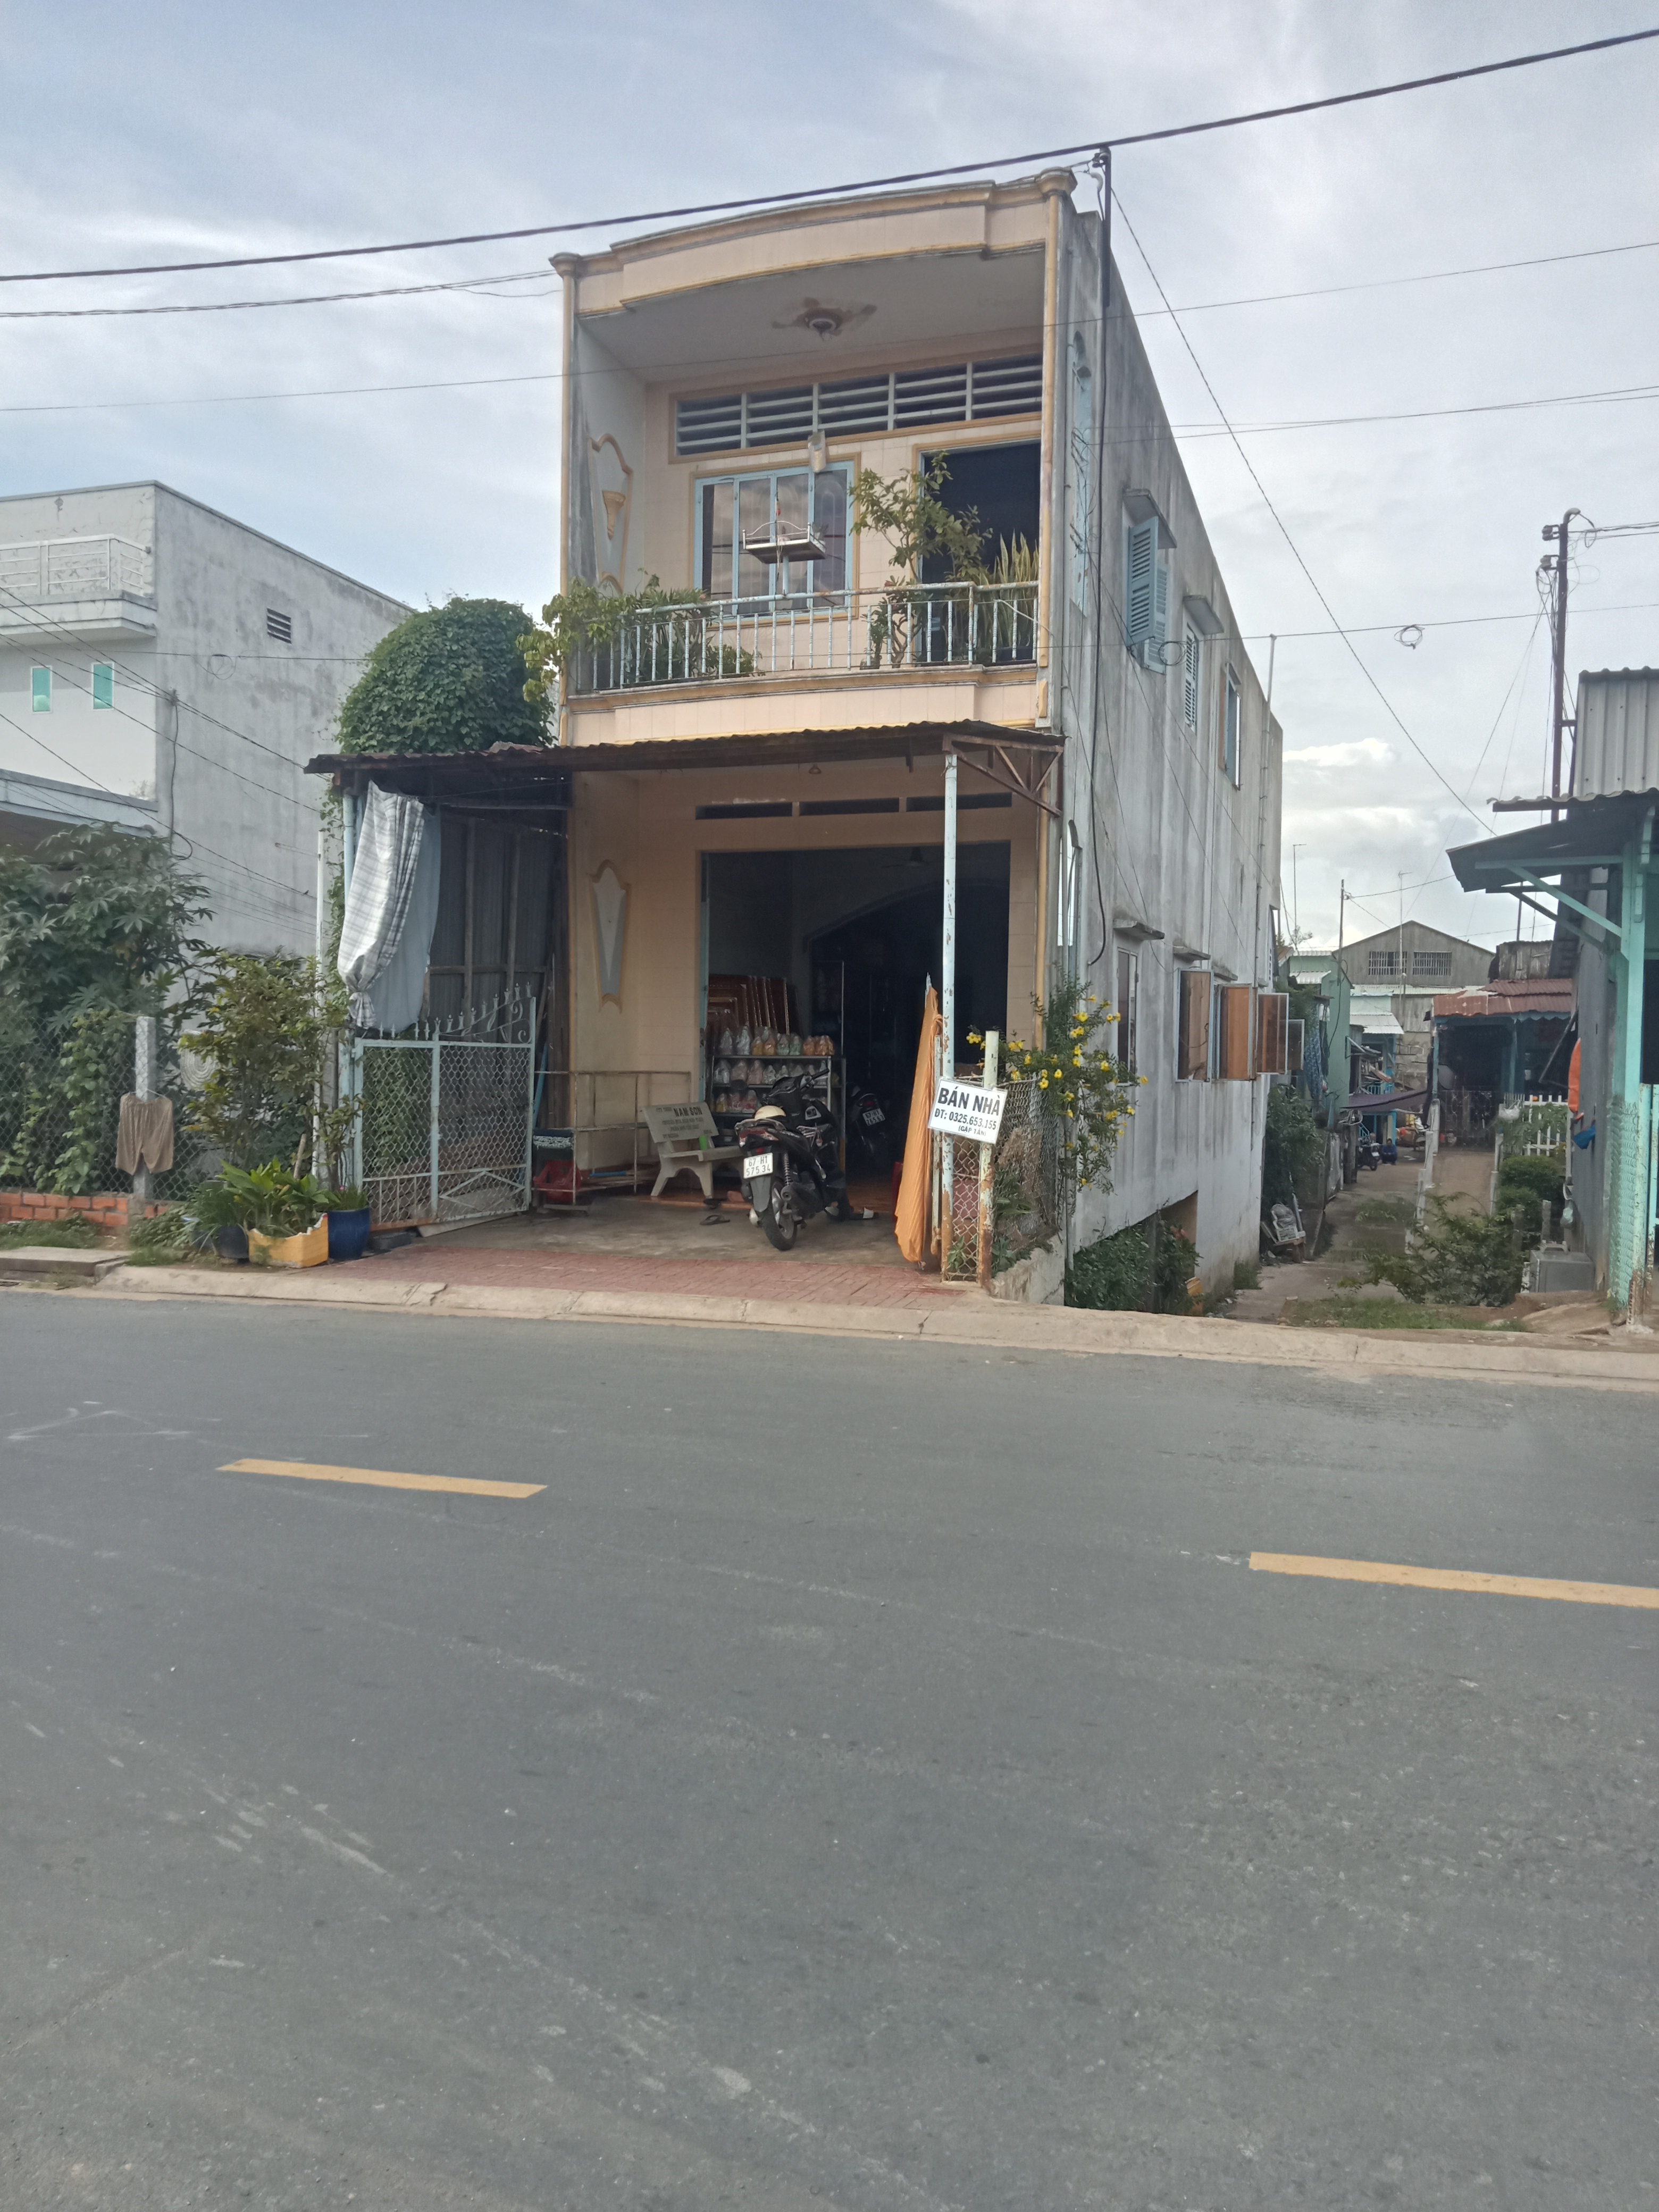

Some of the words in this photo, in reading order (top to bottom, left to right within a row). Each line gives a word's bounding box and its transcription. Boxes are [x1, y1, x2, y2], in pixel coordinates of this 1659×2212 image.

[937, 1086, 970, 1109] BÁN
[972, 1095, 1000, 1116] NHÀ
[673, 1107, 689, 1117] NAM
[949, 1111, 997, 1130] 0325.653.155
